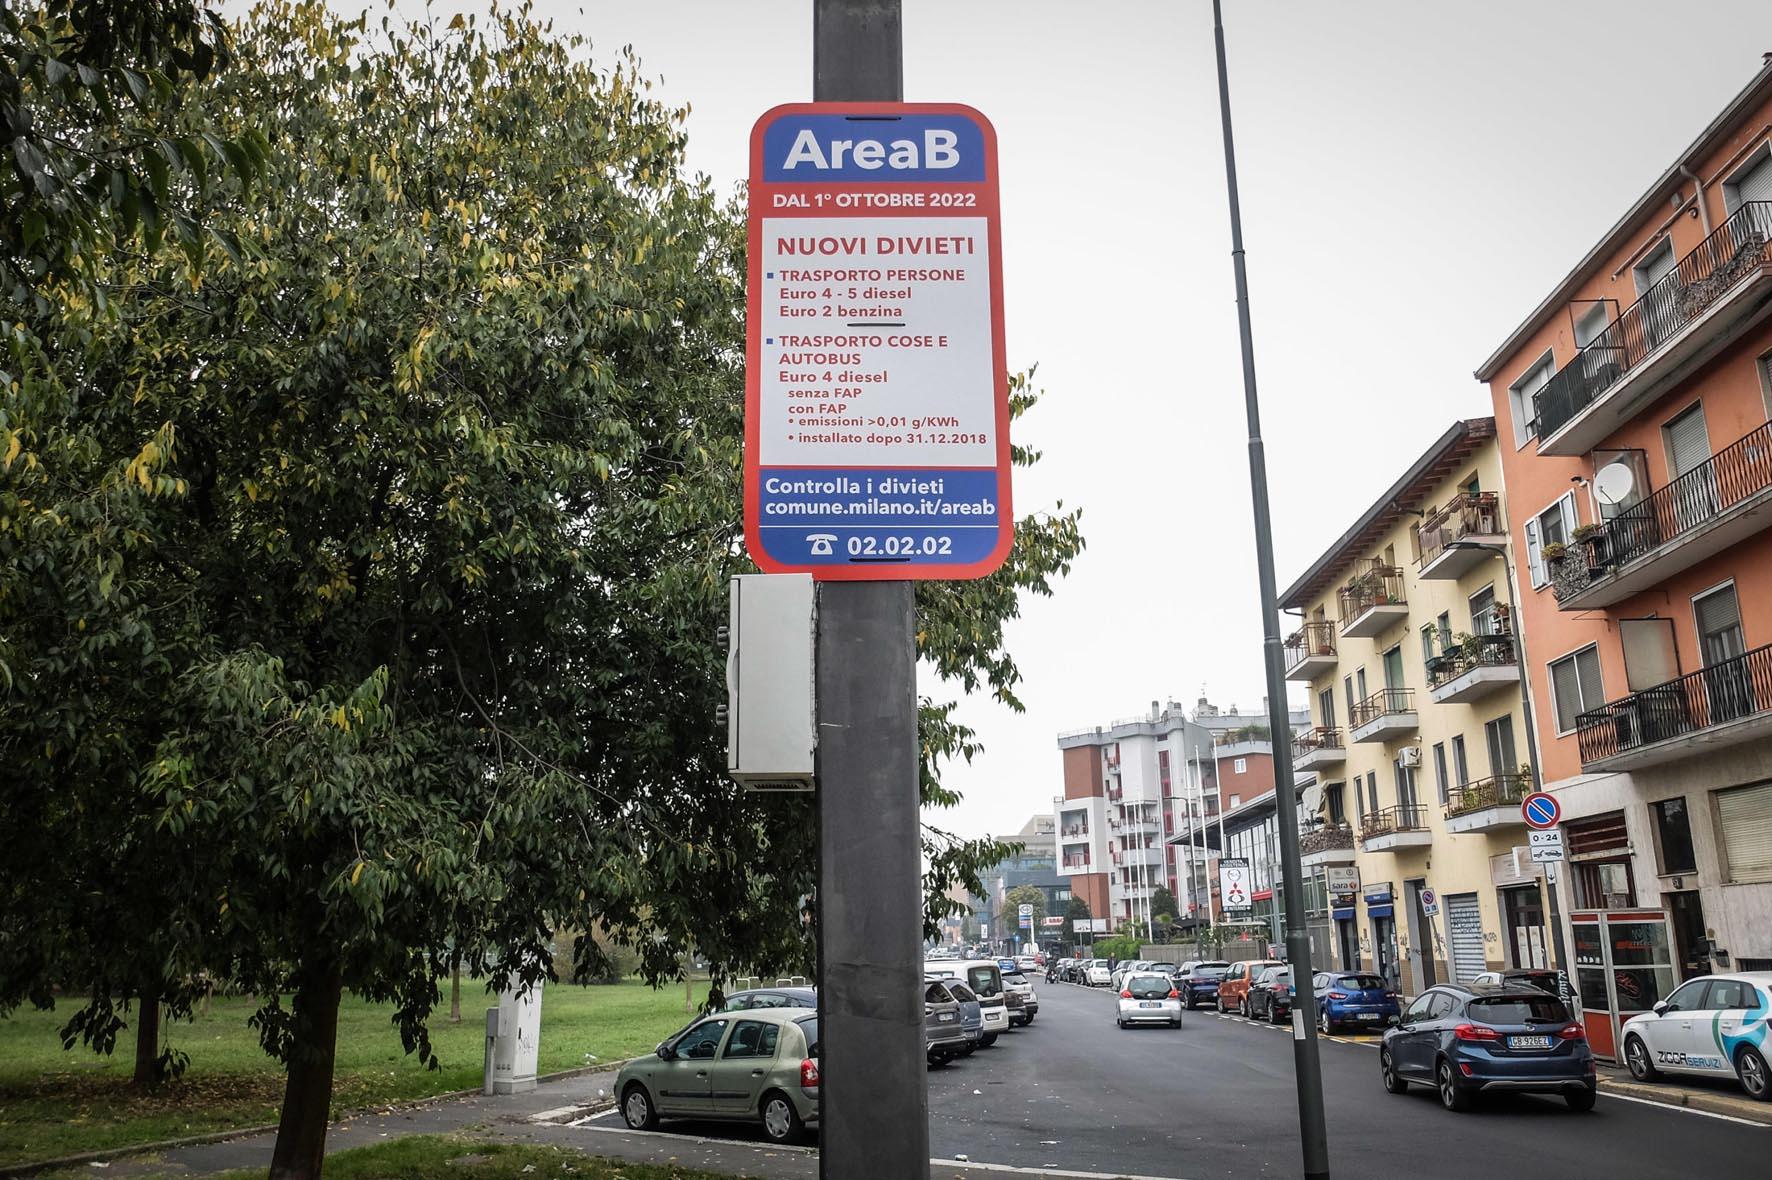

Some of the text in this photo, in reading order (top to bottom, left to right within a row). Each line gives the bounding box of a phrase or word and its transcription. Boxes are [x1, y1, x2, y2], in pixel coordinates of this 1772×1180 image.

[782, 129, 960, 170] AreaB
[773, 193, 977, 208] DAL 1° OTTOBRE 2022
[777, 236, 974, 255] NUOVI DIVIETI
[779, 269, 965, 282] TRASPORTO PERSONE
[780, 287, 817, 300] Euro
[821, 287, 833, 300] 4
[847, 287, 858, 300] 5
[862, 286, 912, 300] diesel
[779, 304, 903, 318] Euro 2 benzina
[778, 335, 948, 348] TRASPORTO COSE E
[778, 353, 861, 365] AUTOBUS
[778, 370, 888, 383] Euro 4 diesel
[788, 387, 862, 399] senza FAP
[788, 403, 847, 415] con FAP
[798, 416, 959, 430] emissioni >0,01 g/KWh
[798, 432, 987, 446] installato dopo 31.12.2018
[765, 477, 944, 495] Controlla i divieti
[765, 497, 996, 516] comune.milano.it/areab
[847, 536, 952, 556] 02.02.02
[1532, 834, 1539, 842] 0
[1546, 834, 1558, 842] 24
[1332, 881, 1349, 890] sara
